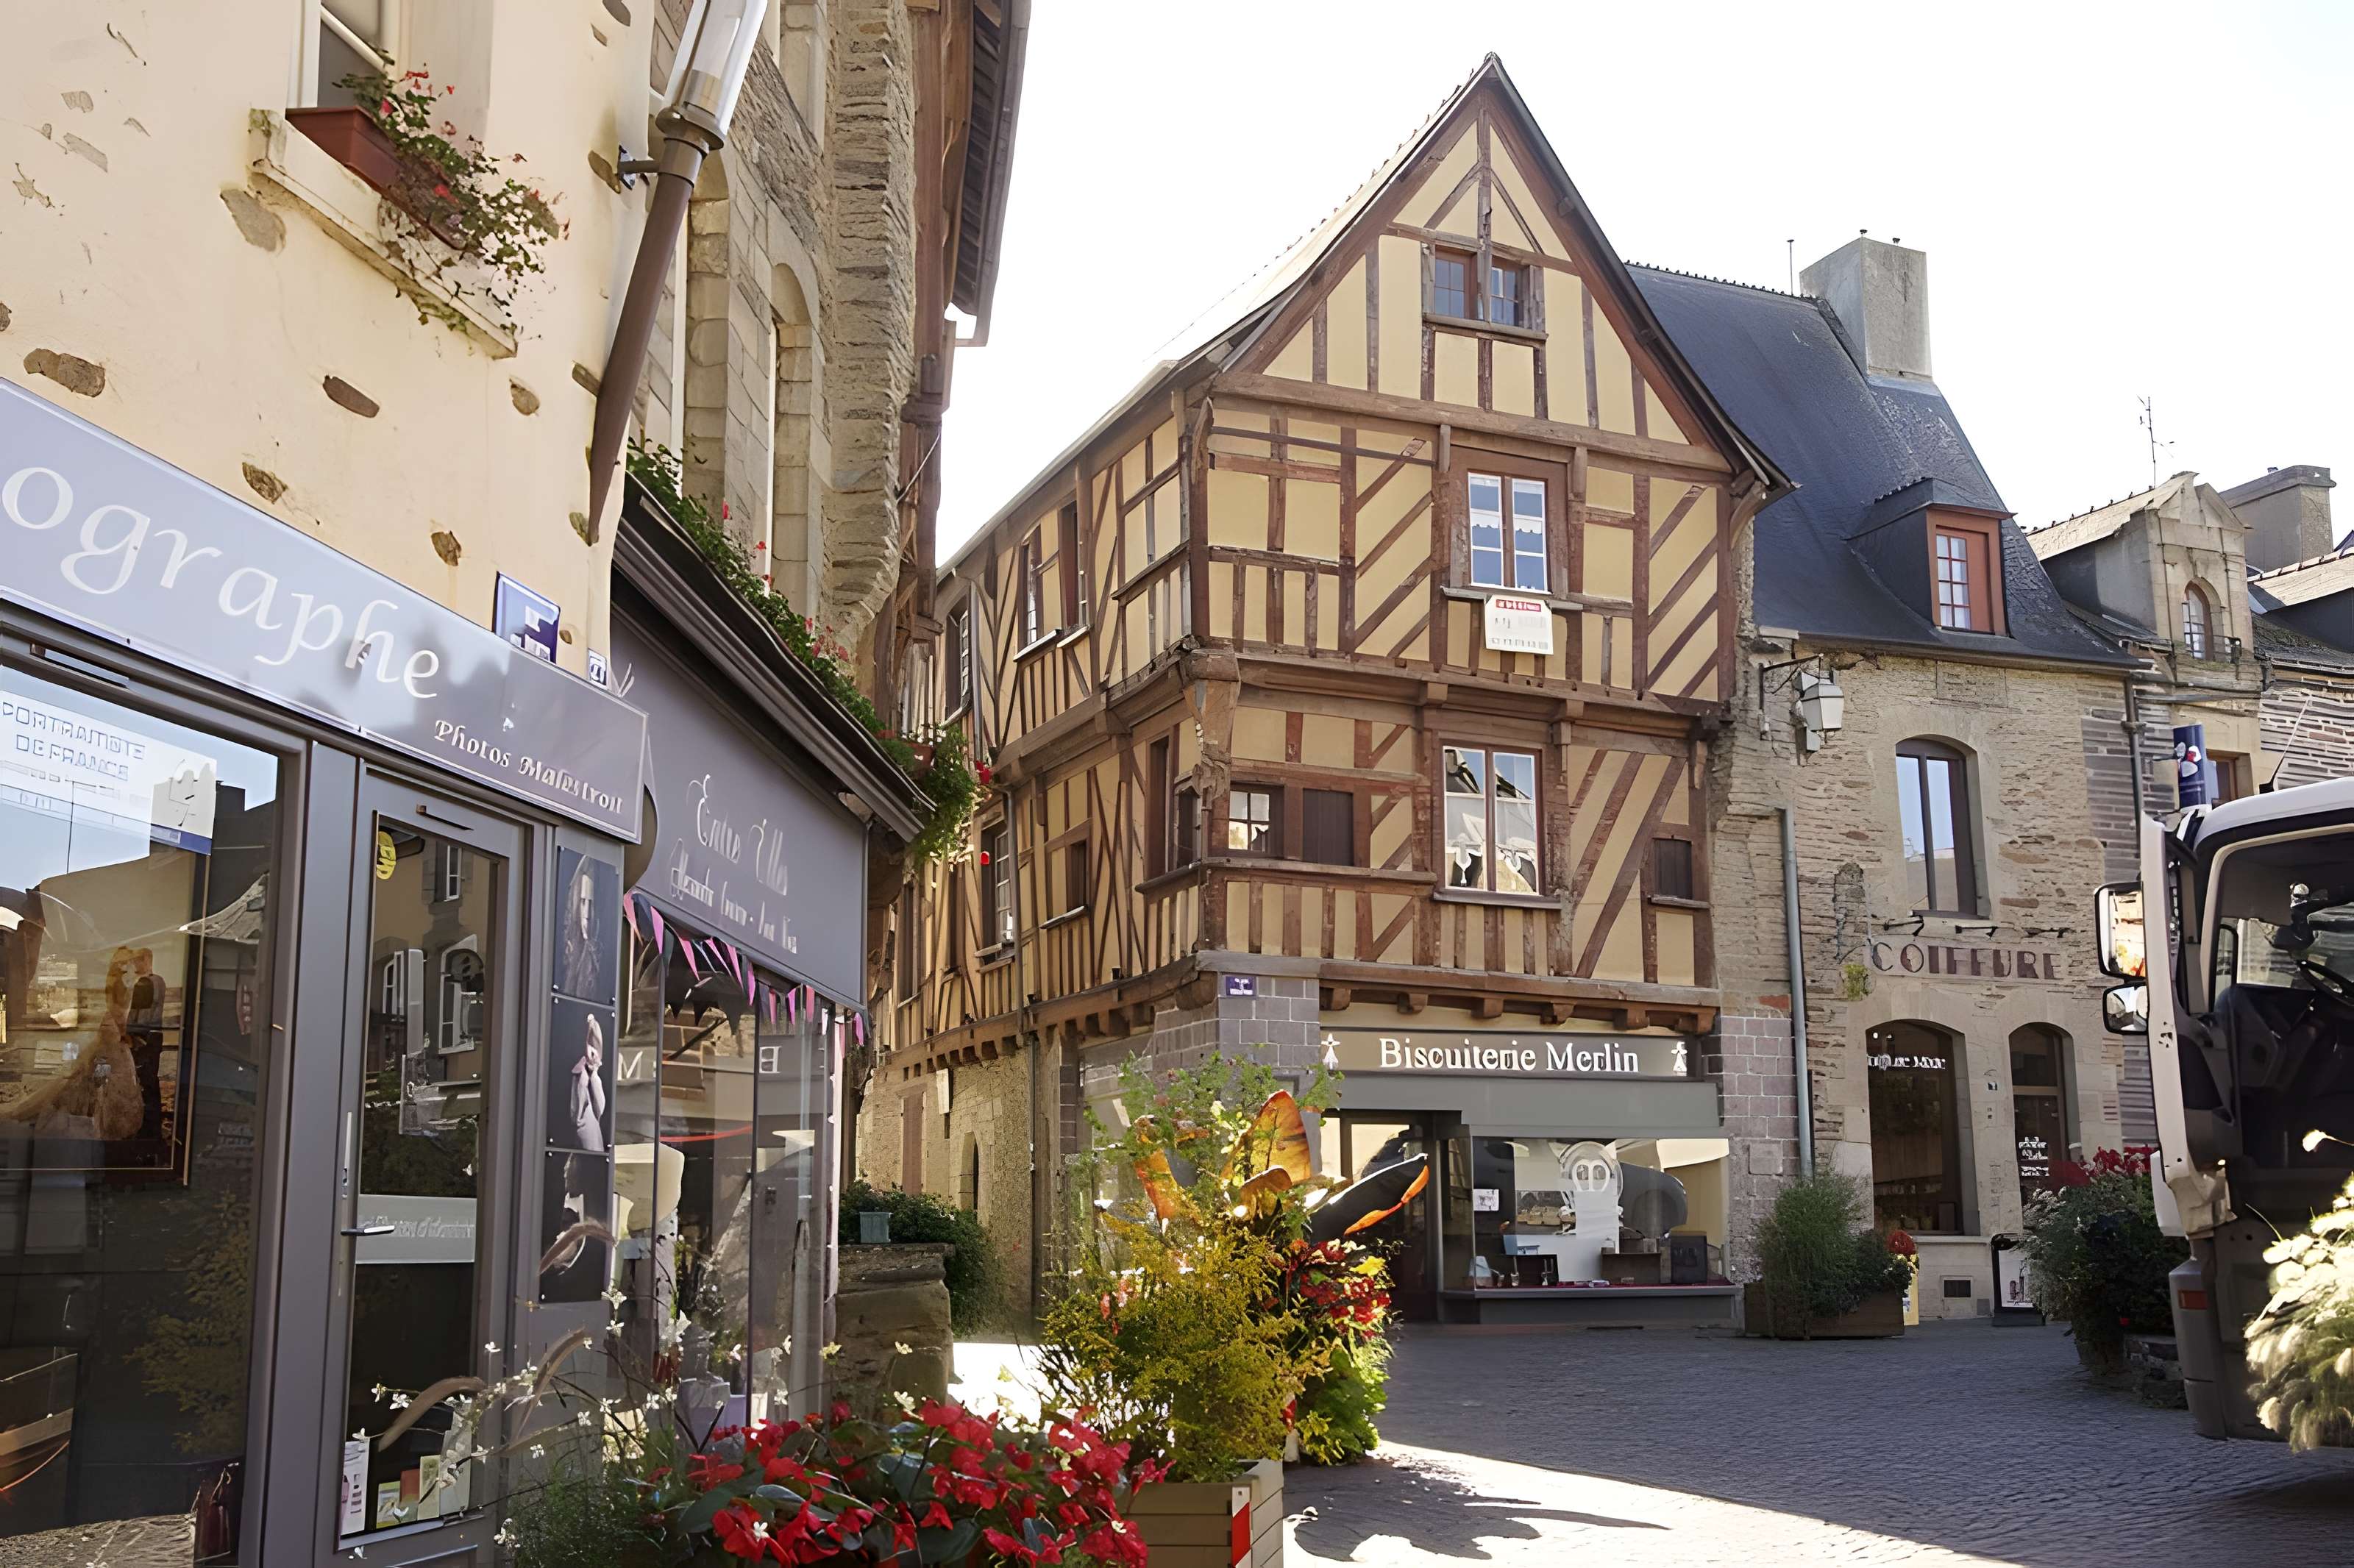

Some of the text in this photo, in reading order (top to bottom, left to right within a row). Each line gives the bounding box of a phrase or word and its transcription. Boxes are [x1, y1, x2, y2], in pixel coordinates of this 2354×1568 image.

[1, 466, 440, 699] ographe
[434, 719, 512, 769] Photos
[1871, 941, 2064, 980] COIFFURE
[1379, 1038, 1640, 1073] Biscuiterie Merlin
